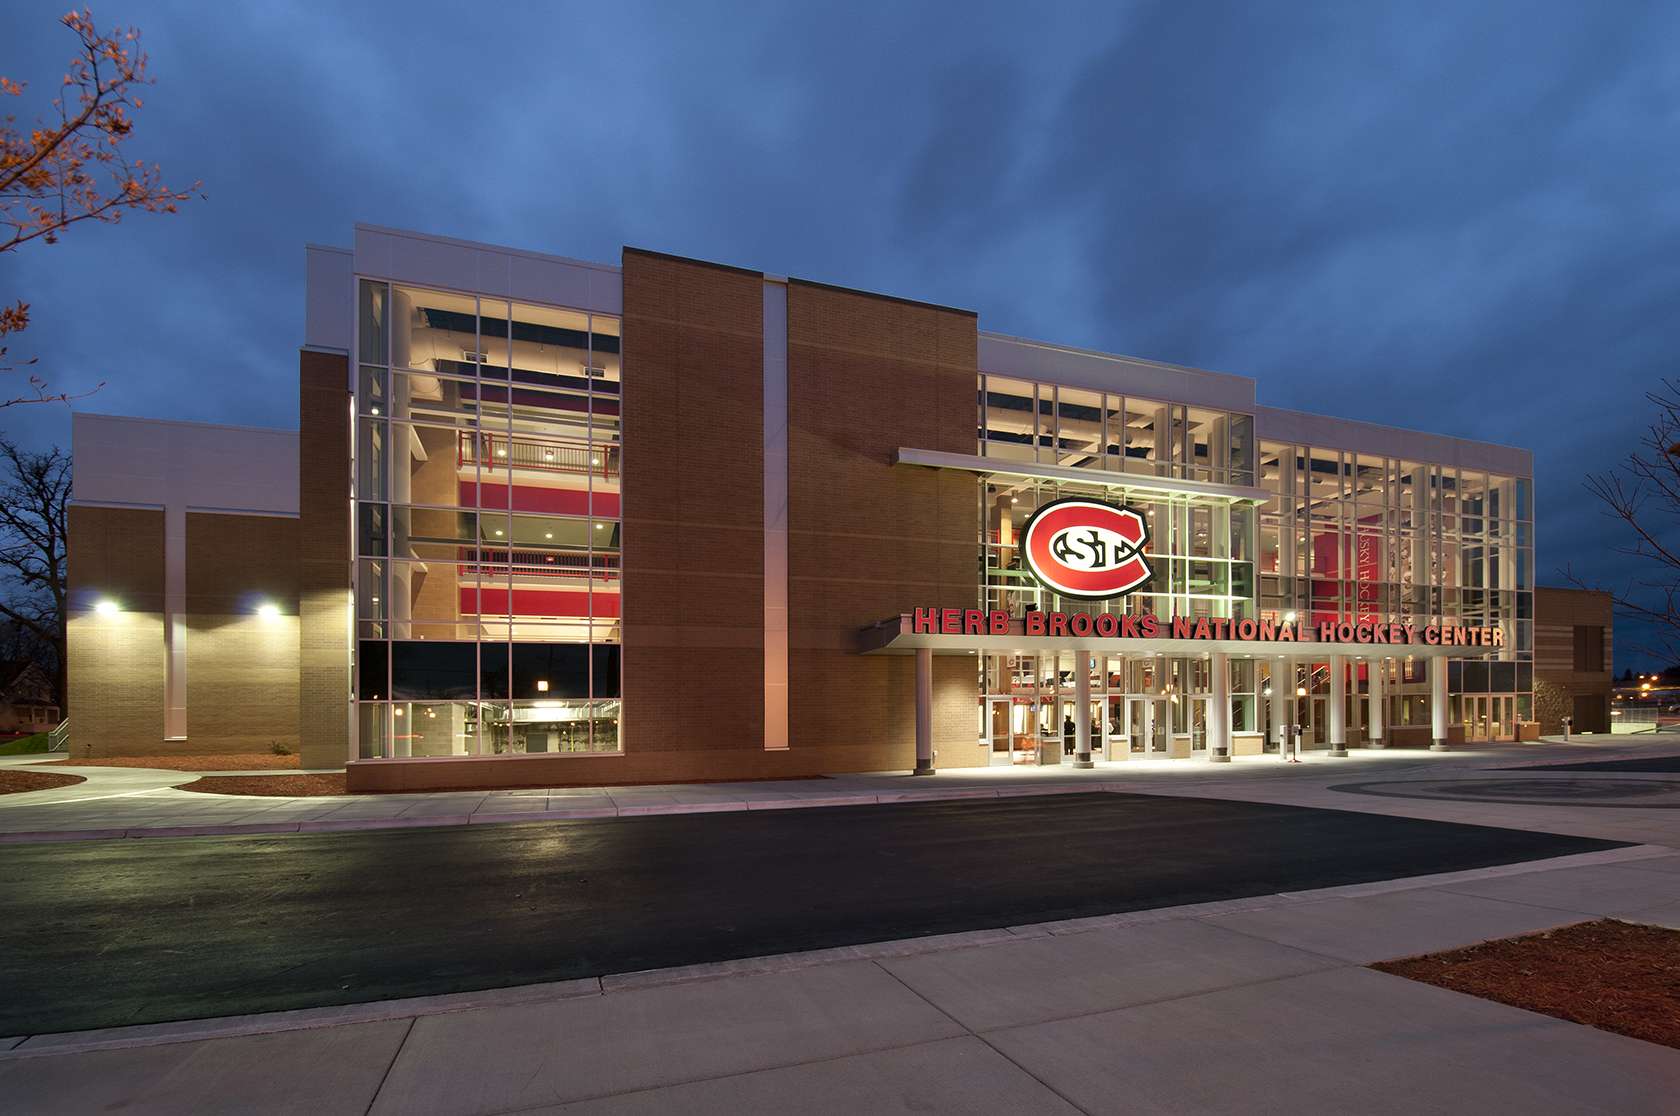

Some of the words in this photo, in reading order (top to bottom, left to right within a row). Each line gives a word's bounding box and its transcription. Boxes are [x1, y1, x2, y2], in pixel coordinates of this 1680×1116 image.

[913, 606, 1010, 634] HERB
[1024, 610, 1161, 639] BROOKS
[1171, 615, 1310, 642] NATIONAL
[1320, 621, 1417, 644] HOCKEY
[1424, 624, 1504, 647] CENTER
